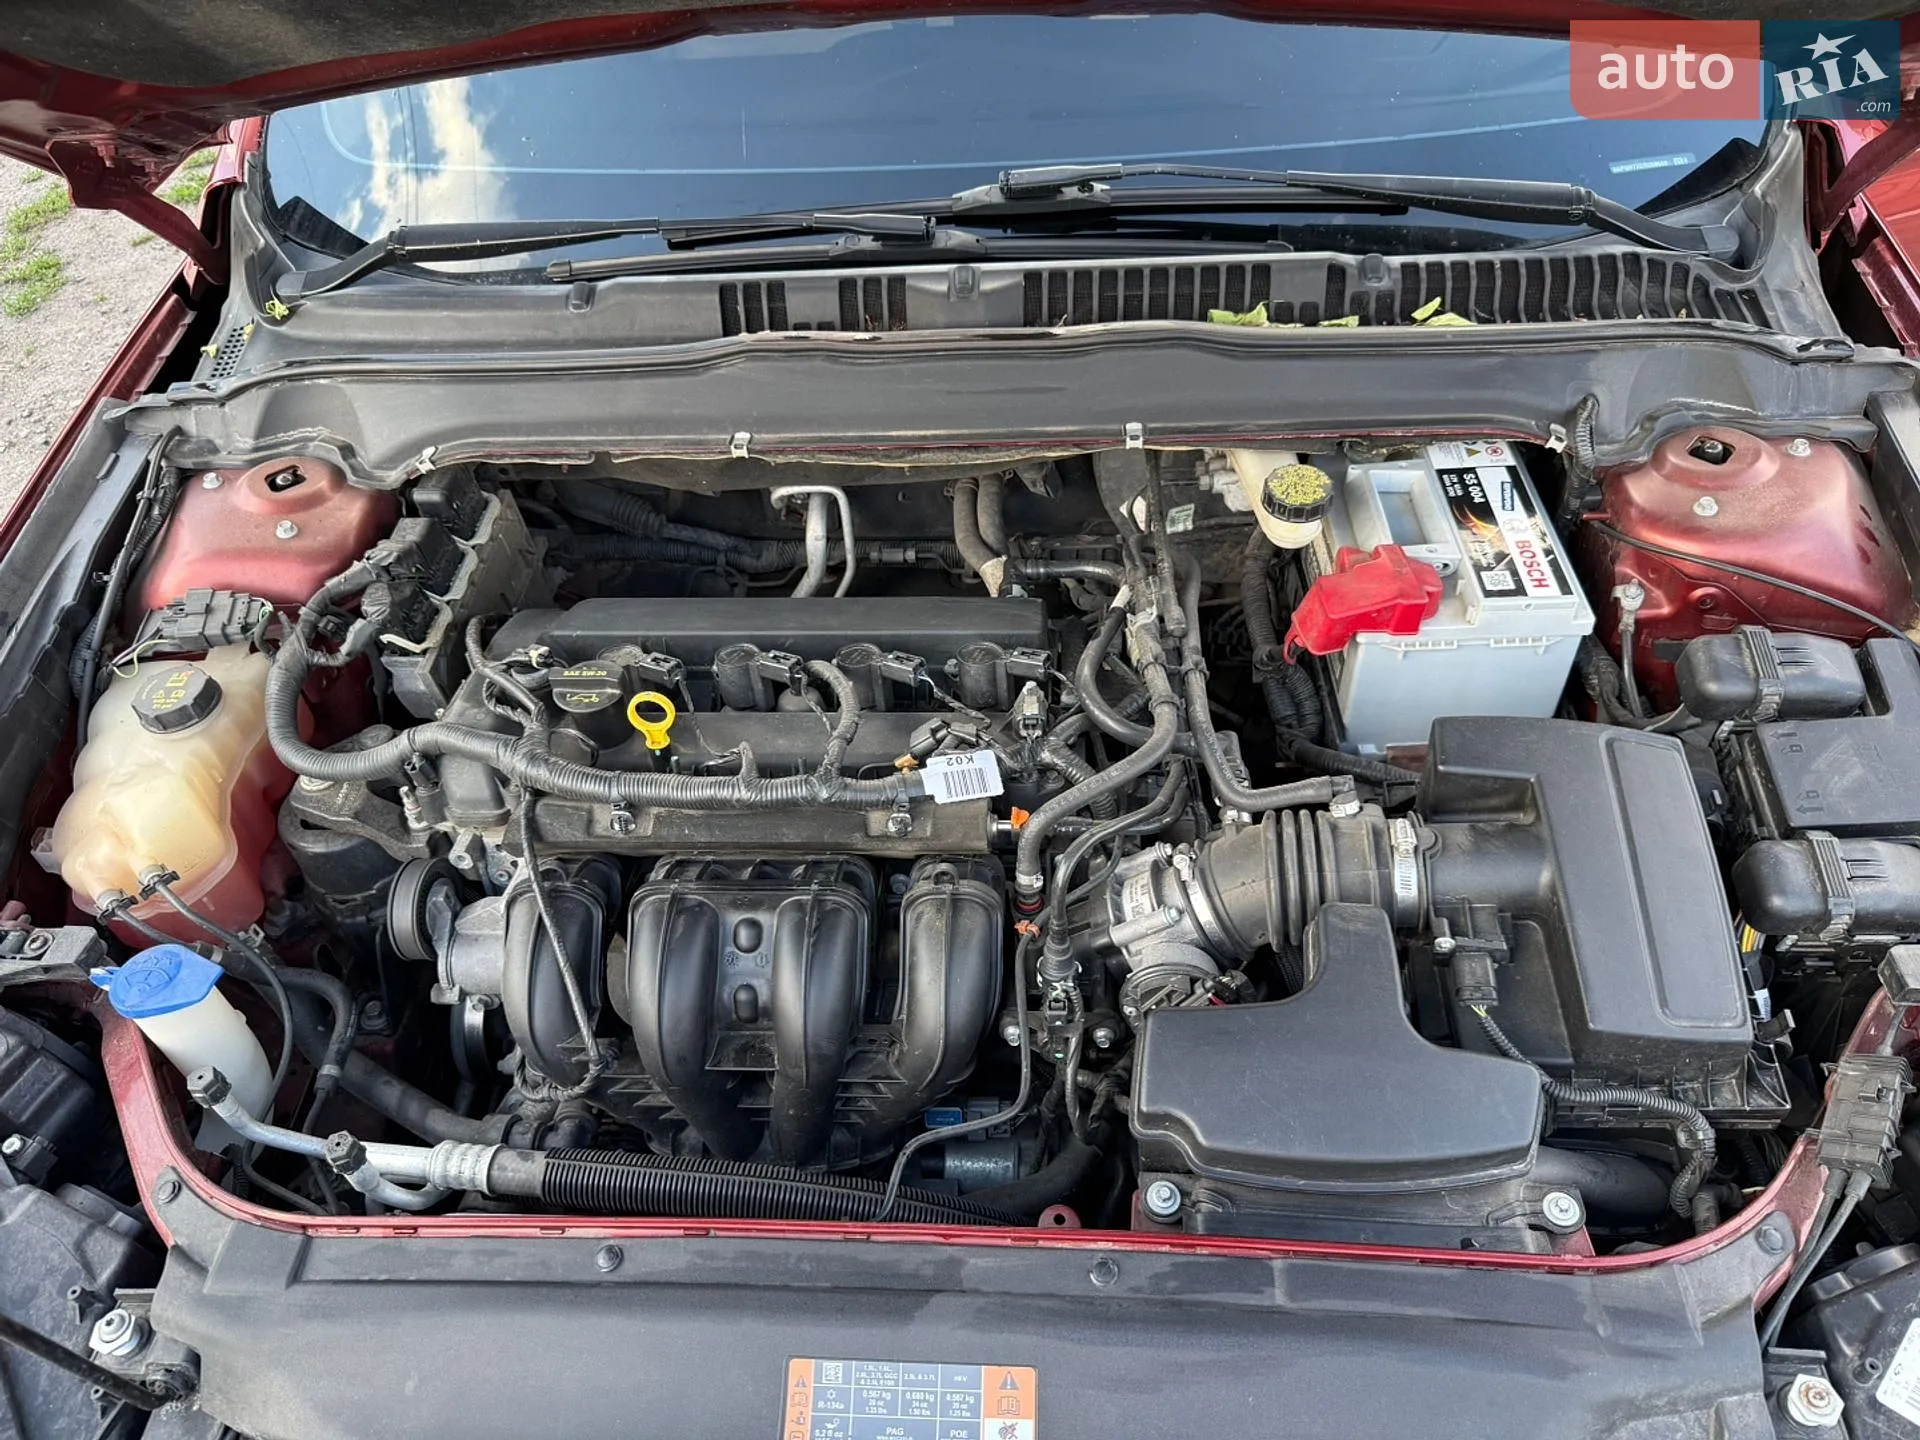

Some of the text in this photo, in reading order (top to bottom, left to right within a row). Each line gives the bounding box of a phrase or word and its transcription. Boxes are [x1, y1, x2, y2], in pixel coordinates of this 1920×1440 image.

[1468, 486, 1486, 504] 004
[1514, 540, 1550, 588] BOSCH
[945, 754, 975, 767] K02
[925, 1392, 935, 1402] kg
[965, 1394, 975, 1404] kg
[817, 1400, 844, 1409] R-134a
[886, 1427, 904, 1436] PAG
[950, 1430, 968, 1439] POE
